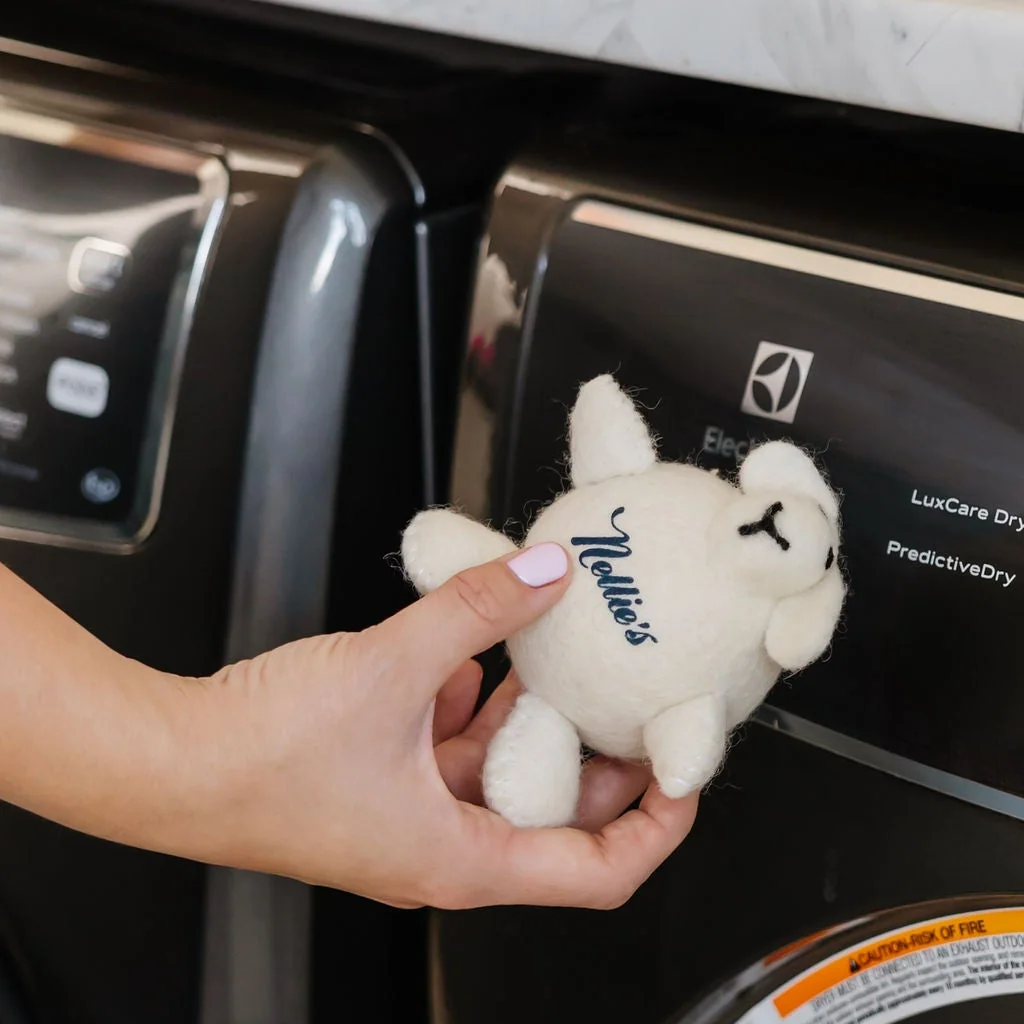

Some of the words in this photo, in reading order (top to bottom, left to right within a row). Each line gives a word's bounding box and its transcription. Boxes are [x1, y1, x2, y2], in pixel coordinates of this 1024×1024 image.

[911, 489, 989, 520] LuxCare
[571, 507, 658, 645] Nellie's
[886, 540, 1016, 587] PredictiveDry
[940, 924, 956, 940] OF
[958, 919, 986, 936] FIRE
[950, 937, 990, 954] EXHAUST
